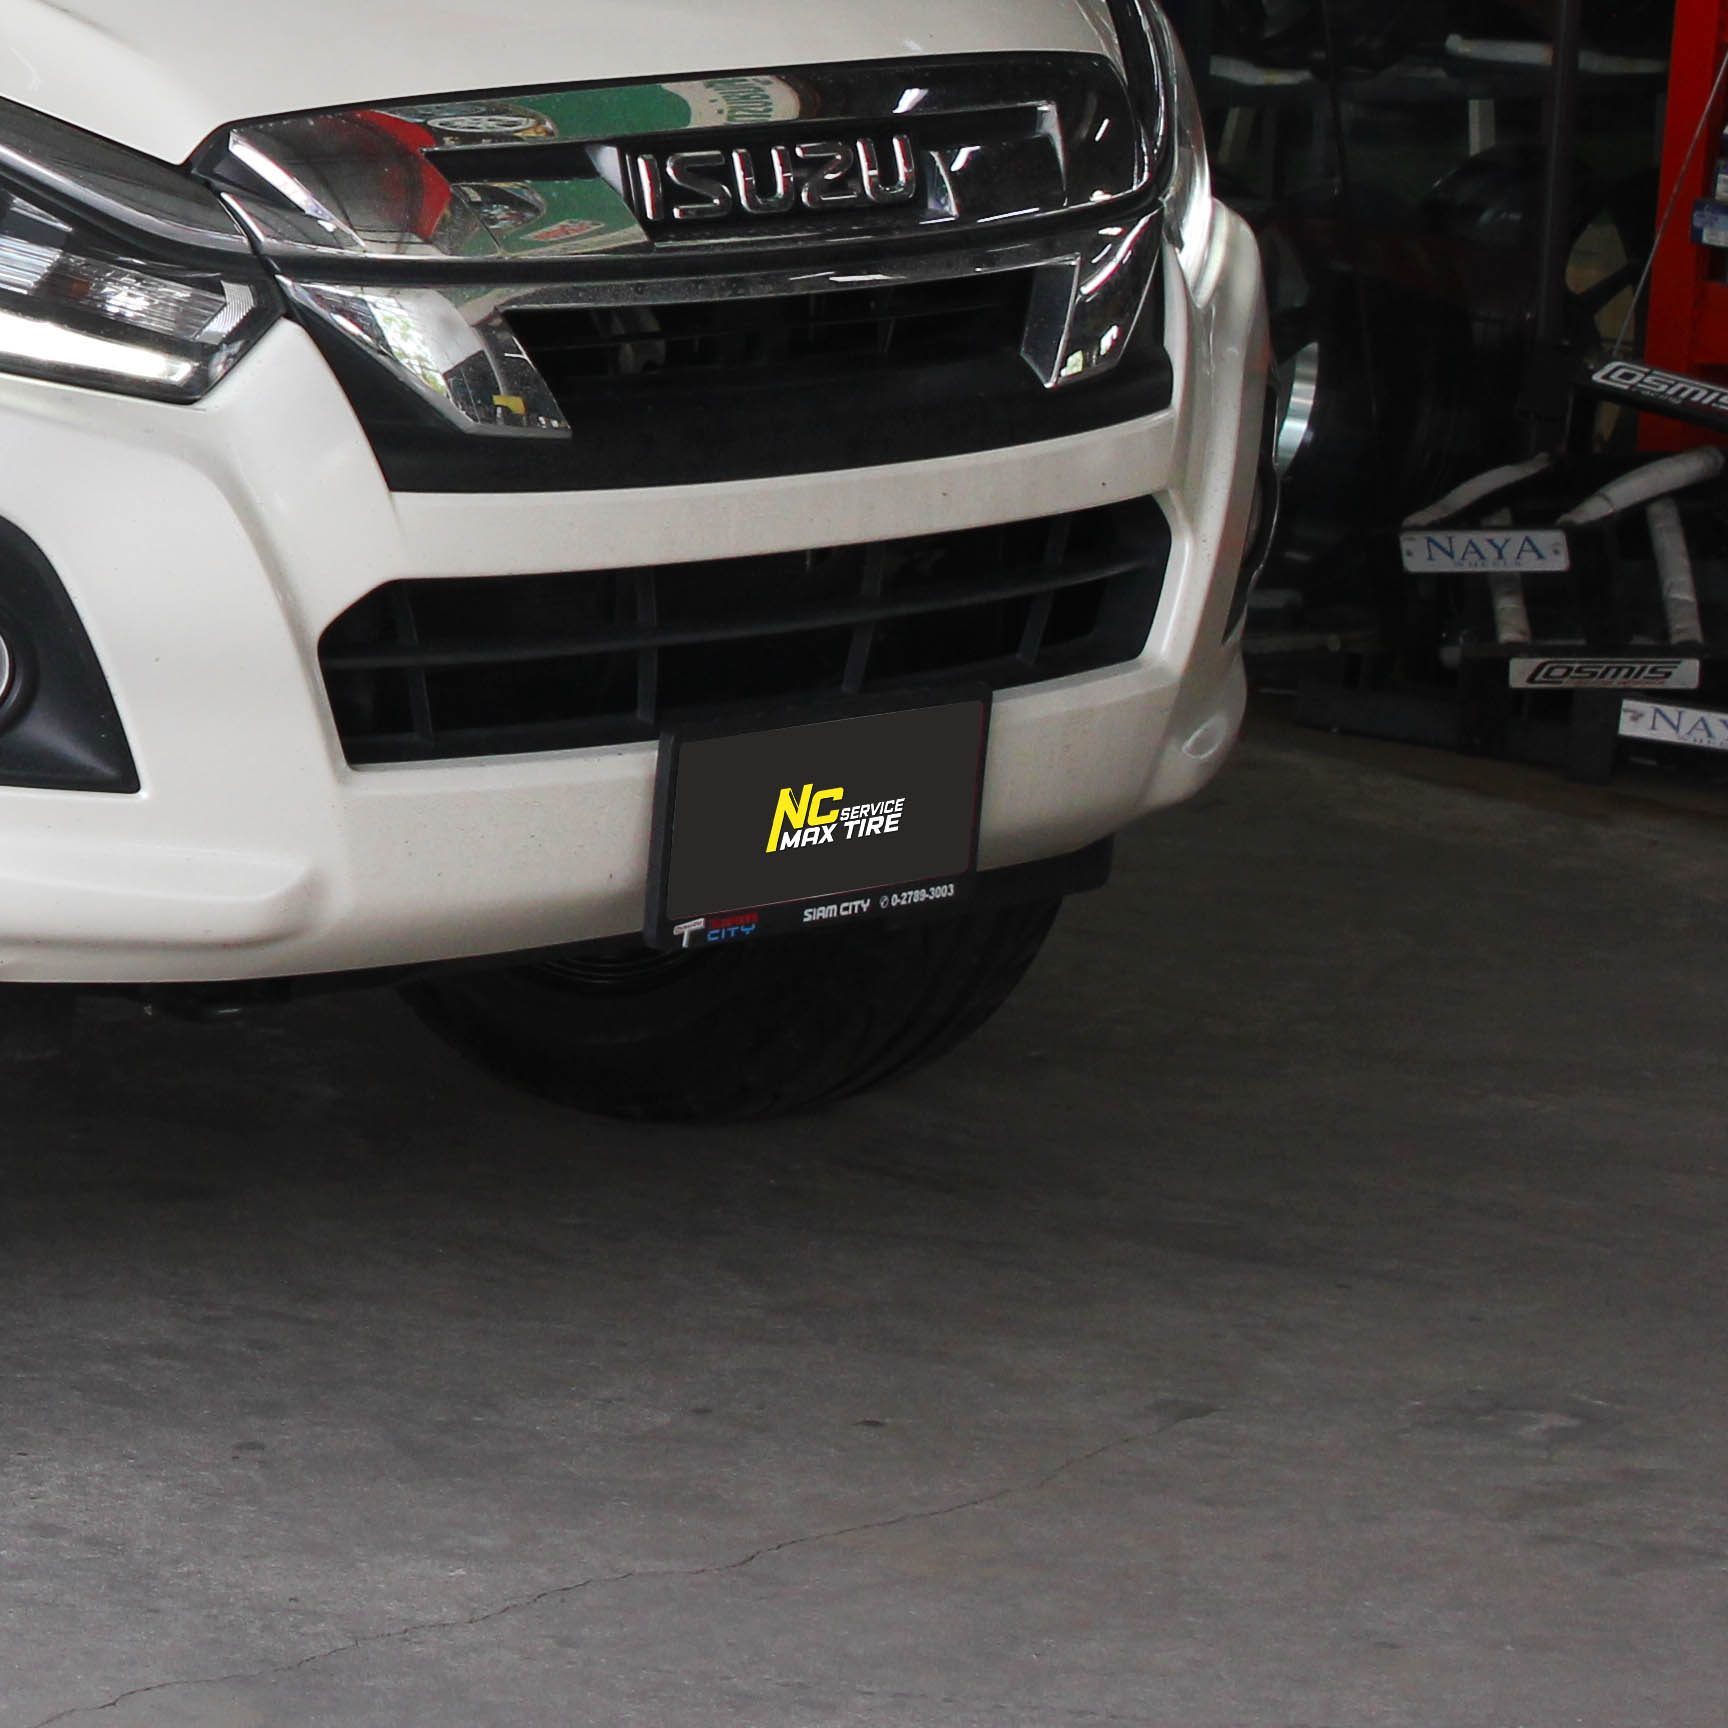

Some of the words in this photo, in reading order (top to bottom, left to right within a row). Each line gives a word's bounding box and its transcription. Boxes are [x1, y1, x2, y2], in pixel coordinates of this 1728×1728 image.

[637, 134, 917, 221] ISUZU
[1424, 535, 1547, 562] NAYA
[802, 902, 838, 923] SIAM
[839, 898, 871, 918] CITY
[706, 922, 756, 941] CITY
